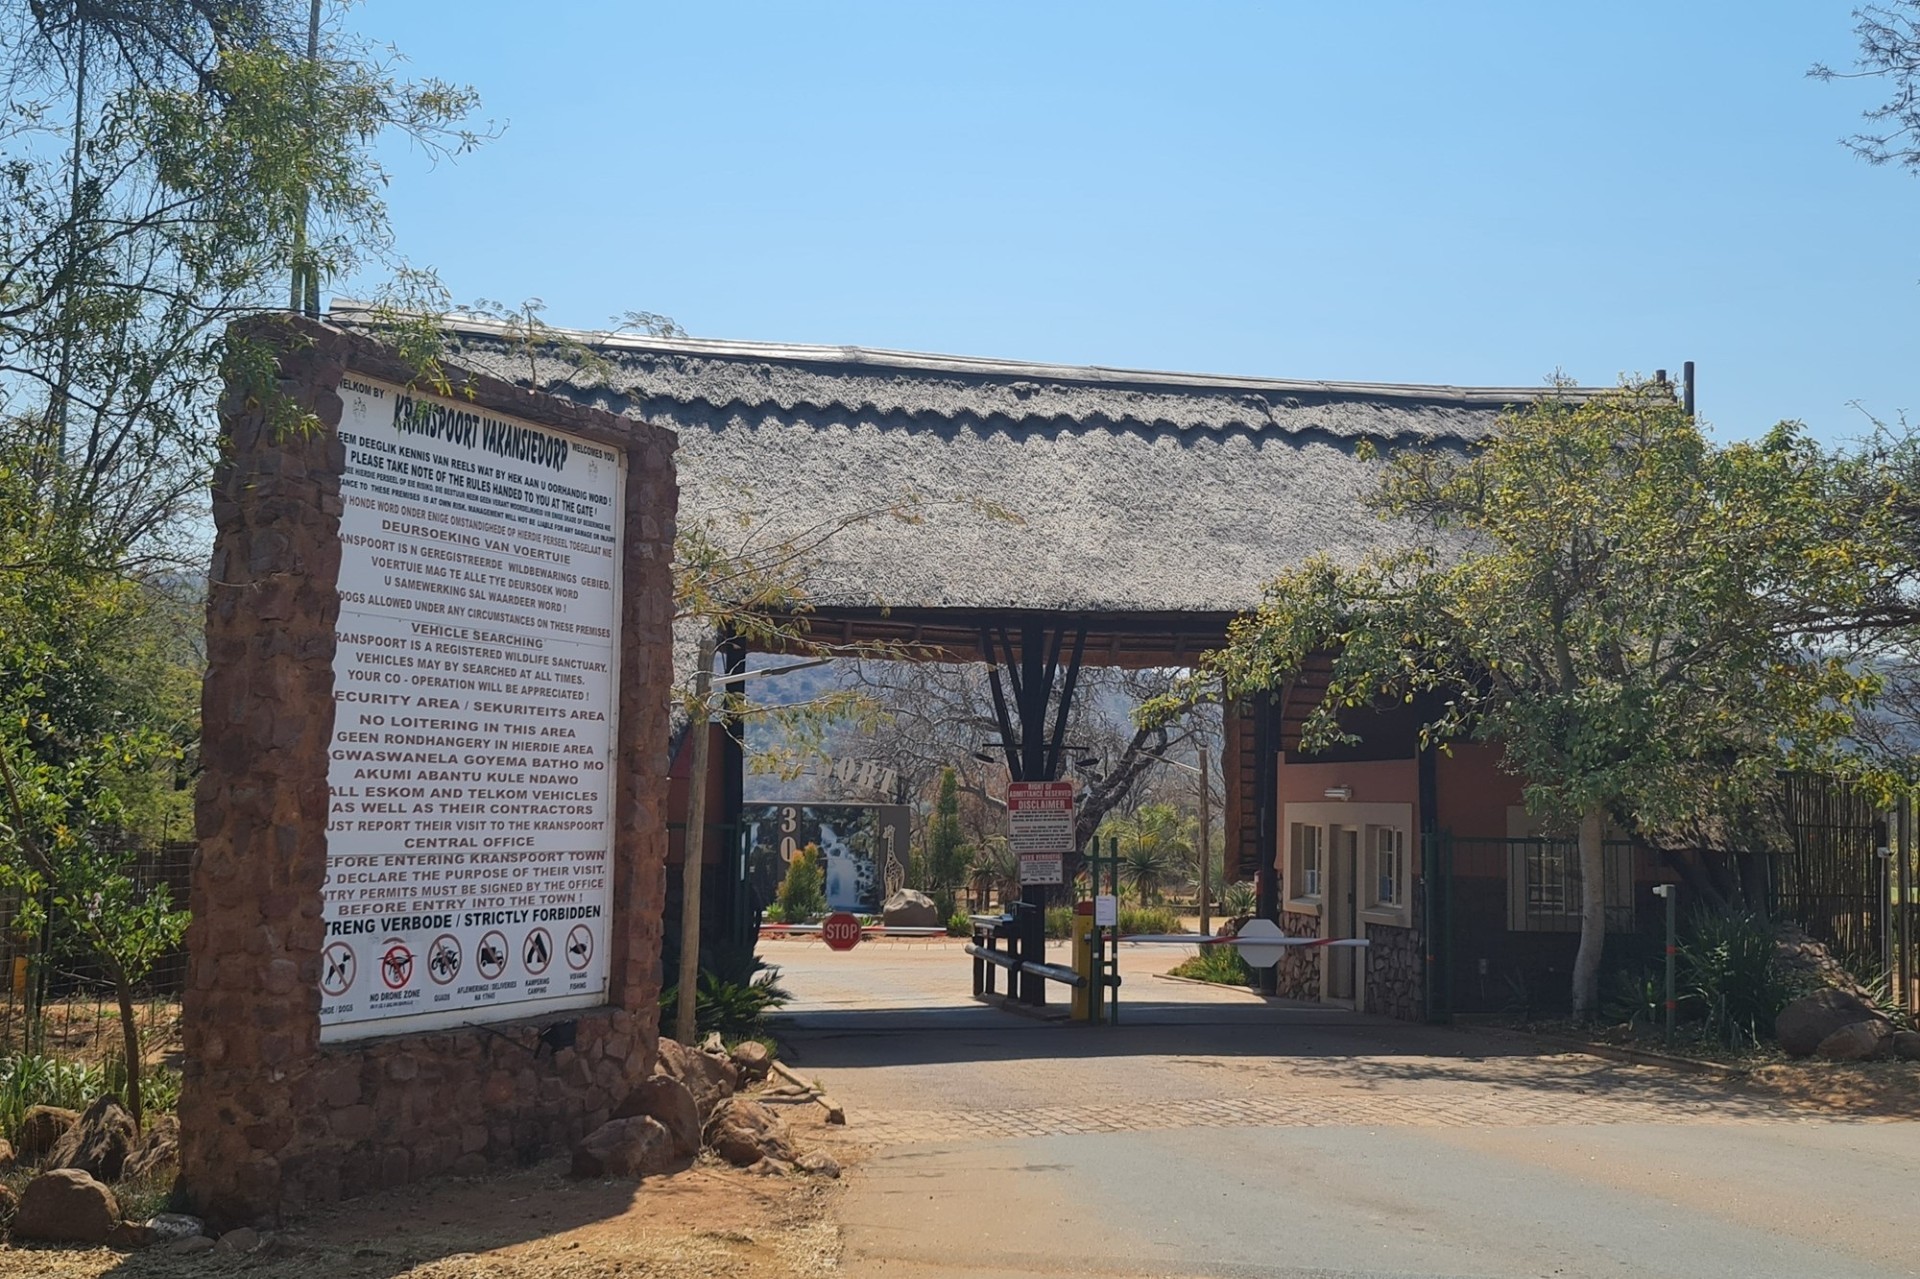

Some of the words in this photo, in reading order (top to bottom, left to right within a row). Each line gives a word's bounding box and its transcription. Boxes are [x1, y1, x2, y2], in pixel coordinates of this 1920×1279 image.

[338, 376, 371, 396] ELKOM
[372, 386, 385, 399] BY
[482, 416, 568, 474] VAKANSIEDORP
[572, 442, 602, 459] WELCOMES
[603, 451, 614, 462] YOU
[359, 435, 396, 454] DEEGLIK
[398, 445, 430, 463] KENNIS
[432, 453, 449, 466] VAN
[450, 458, 475, 473] REELS
[477, 464, 493, 477] WAT
[495, 469, 505, 480] BY
[507, 472, 522, 484] HEK
[524, 476, 539, 488] AAN
[547, 482, 587, 500] OORHANDIG
[588, 492, 607, 505] WORD
[350, 450, 384, 469] PLEASE
[386, 458, 408, 475] TAKE
[410, 463, 433, 480] NOTE
[448, 472, 464, 487] THE
[466, 476, 491, 493] RULES
[492, 483, 522, 500] HANDED
[524, 490, 534, 503] TO
[535, 493, 550, 507] YOU
[561, 499, 575, 513] THE
[576, 503, 593, 517] GATE
[349, 494, 375, 510] HONDE
[377, 500, 399, 514] WORD
[400, 505, 426, 520] ONDER
[427, 510, 448, 524] ENIGE
[381, 518, 480, 548] DEURSOEKING
[484, 538, 509, 552] VAN
[512, 544, 570, 564] VOERTUIE
[370, 555, 423, 574] VOERTUIE
[424, 564, 447, 577] MAG
[462, 570, 486, 583] ALLE
[488, 574, 506, 587] TYE
[507, 578, 553, 595] DEURSOEK
[554, 586, 578, 599] WORD
[419, 545, 503, 571] GEREGISTREERDE
[507, 562, 577, 584] WILDBEWARINGS
[580, 576, 611, 590] GEBIED.
[394, 576, 466, 598] SAMEWERKING
[468, 588, 486, 600] SAL
[488, 591, 536, 608] WAARDEER
[537, 599, 561, 612] WORD
[367, 593, 412, 610] ALLOWED
[414, 600, 445, 614] UNDER
[447, 604, 465, 616] ANY
[467, 607, 535, 627] CIRCUMSTANCES
[549, 620, 574, 632] THESE
[575, 624, 610, 638] PREMISES
[410, 622, 468, 639] VEHICLE
[472, 630, 543, 649] SEARCHING
[355, 651, 414, 668] VEHICLES
[416, 658, 441, 670] MAY
[444, 660, 460, 672] BY
[462, 662, 517, 678] SEARCHED
[534, 670, 552, 681] ALL
[553, 672, 585, 685] TIMES.
[435, 642, 502, 660] REGISTERED
[504, 651, 549, 665] WILDLIFE
[551, 656, 607, 672] SANCTUARY.
[347, 669, 380, 682] YOUR
[478, 681, 502, 692] WILL
[520, 685, 584, 700] APPRECIATED
[416, 696, 460, 709] AREA
[473, 701, 566, 718] SEKURITEITS
[569, 709, 605, 721] AREA
[359, 714, 385, 726] NO
[390, 715, 478, 731] LOITERING
[483, 722, 499, 732] IN
[503, 723, 536, 735] THIS
[539, 726, 576, 737] AREA
[336, 731, 378, 743] GEEN
[384, 732, 491, 749] RONDHANGERY
[494, 739, 508, 749] IN
[511, 740, 559, 752] HIERDIE
[562, 744, 593, 754] AREA
[463, 754, 527, 767] GOYEMA
[531, 758, 579, 769] BATHO
[583, 760, 604, 770] MO
[353, 768, 411, 780] AKUMI
[416, 770, 481, 781] ABANTU
[486, 772, 524, 783] KULE
[529, 774, 578, 784] NDAWO
[327, 785, 359, 798] ALL
[364, 786, 424, 798] ESKOM
[429, 788, 463, 798] AND
[467, 788, 527, 799] TELKOM
[531, 790, 598, 801] VEHICLES
[330, 802, 355, 812] AS
[360, 802, 407, 813] WELL
[411, 803, 433, 813] AS
[438, 803, 485, 813] THEIR
[489, 804, 593, 814] CONTRACTORS
[1018, 800, 1065, 810] DISCLAIMER
[357, 820, 411, 830] REPORT
[413, 820, 452, 830] THEIR
[455, 820, 487, 830] VISIT
[489, 820, 505, 830] TO
[507, 821, 530, 830] THE
[533, 821, 604, 830] KRANSPOORT
[403, 837, 478, 848] CENTRAL
[482, 836, 535, 847] OFFICE
[385, 853, 464, 866] ENTERING
[470, 852, 563, 863] KRANSPOORT
[569, 851, 604, 860] TOWN
[336, 871, 407, 883] DECLARE
[411, 870, 440, 881] THE
[445, 868, 508, 880] PURPOSE
[532, 866, 569, 876] THEIR
[572, 865, 604, 874] VISIT.
[359, 886, 417, 899] PERMITS
[421, 885, 457, 896] MUST
[480, 882, 522, 893] SIGNED
[526, 881, 540, 891] BY
[543, 880, 564, 890] THE
[568, 878, 603, 889] OFFICE
[338, 901, 406, 915] BEFORE
[412, 898, 466, 911] ENTRY
[472, 897, 505, 908] INTO
[509, 895, 535, 906] THE
[539, 893, 575, 904] TOWN
[380, 914, 452, 932] VERBODE
[464, 909, 529, 926] STRICTLY
[532, 905, 601, 921] FORBIDDEN
[827, 924, 858, 938] STOP
[370, 993, 379, 1002] NO
[380, 990, 401, 1001] DRONE
[403, 988, 419, 998] ZONE
